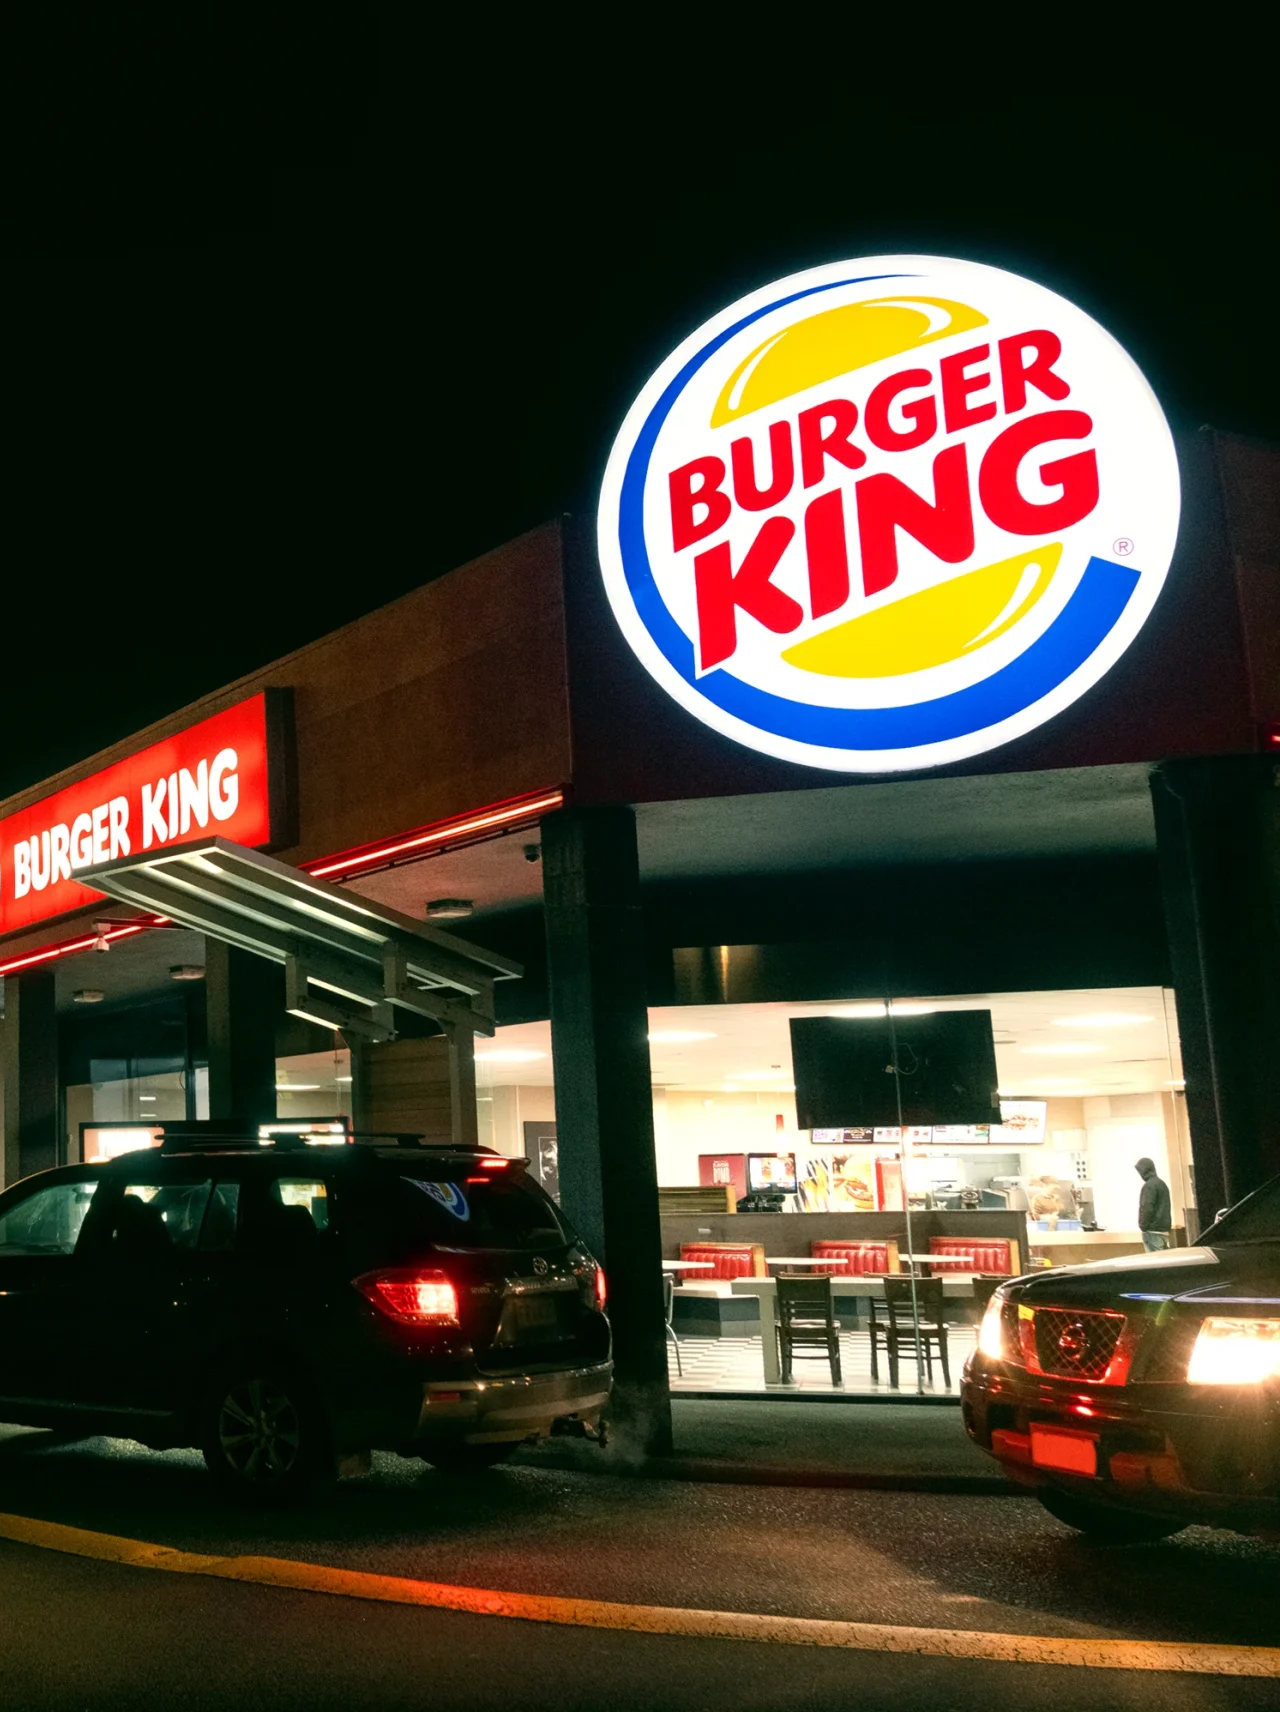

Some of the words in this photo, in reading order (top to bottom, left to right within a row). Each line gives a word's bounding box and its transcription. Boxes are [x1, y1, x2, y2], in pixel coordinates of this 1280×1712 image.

[668, 329, 1071, 553] BURGER
[694, 410, 1100, 672] KING
[14, 796, 130, 899] BURGER
[141, 748, 239, 849] KING
